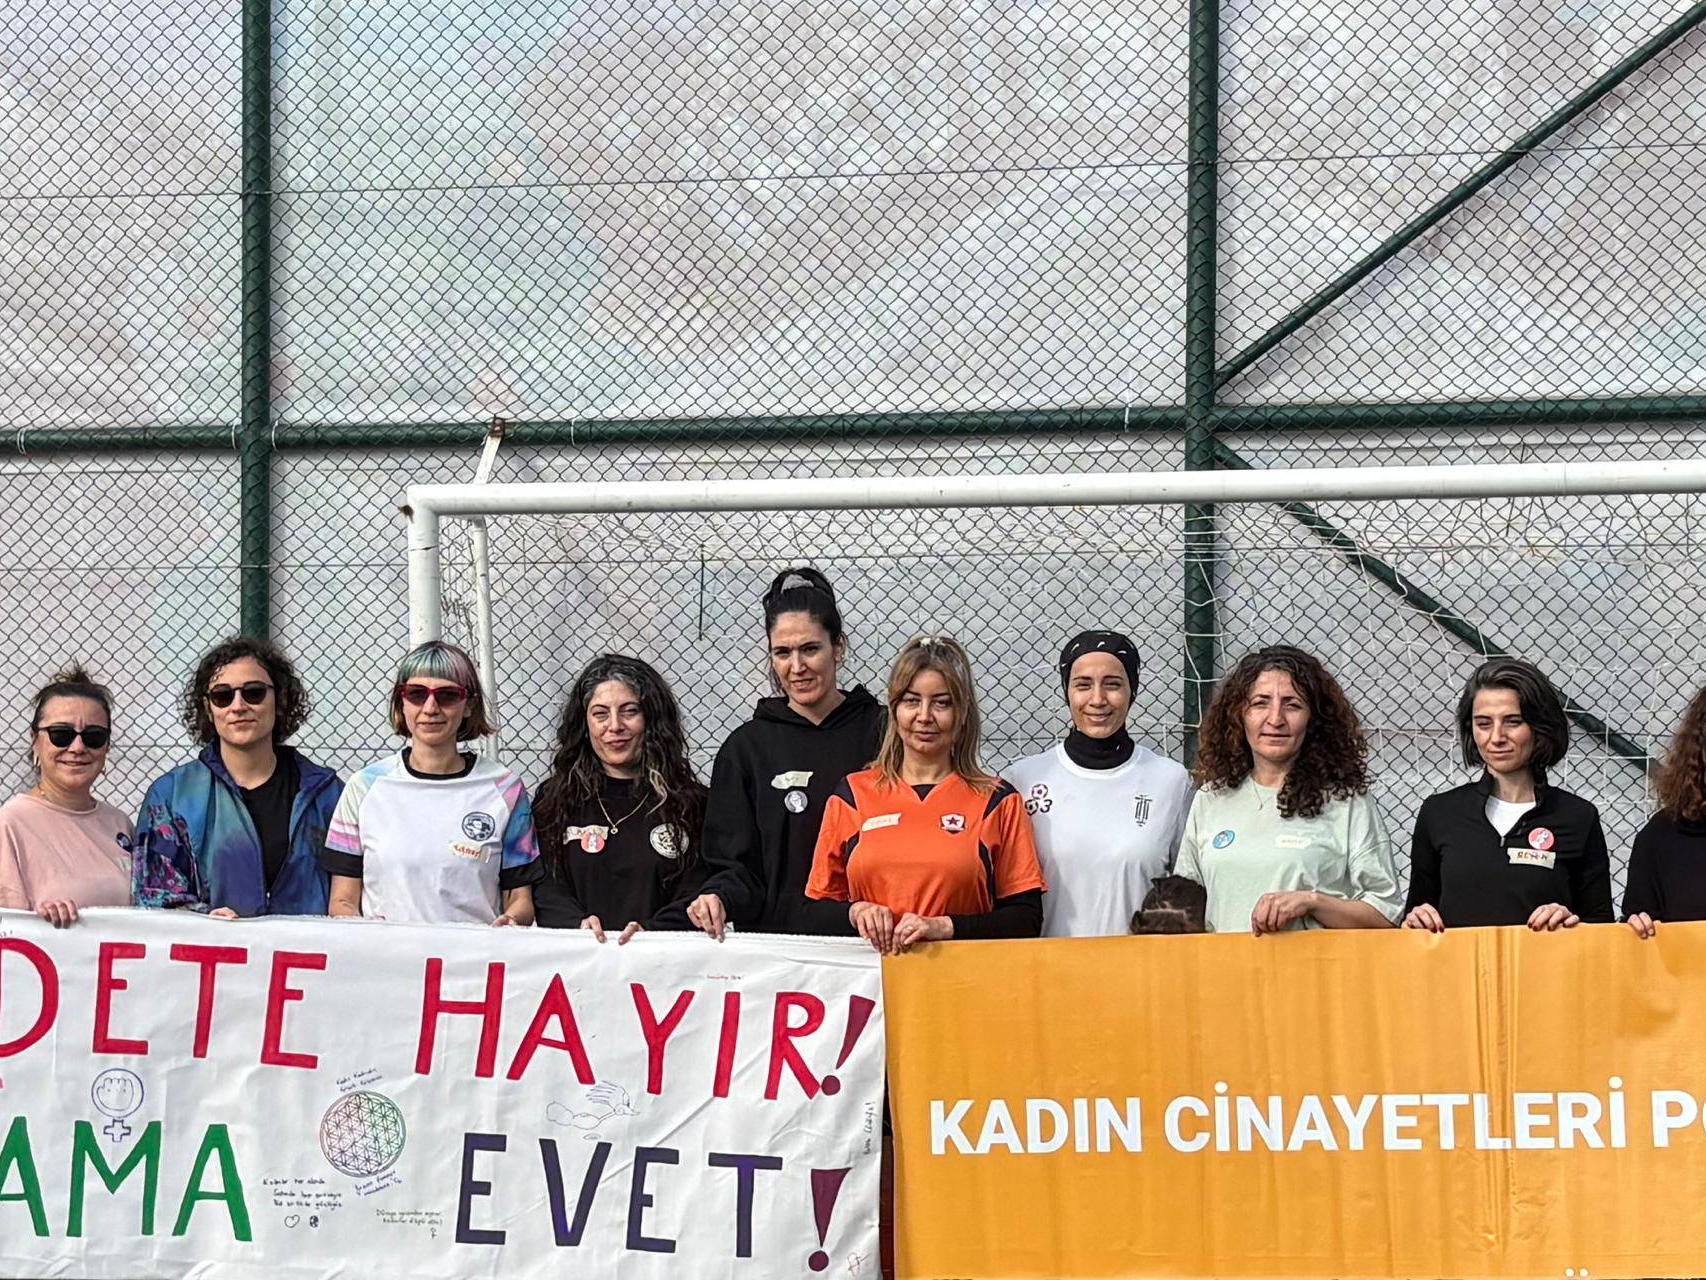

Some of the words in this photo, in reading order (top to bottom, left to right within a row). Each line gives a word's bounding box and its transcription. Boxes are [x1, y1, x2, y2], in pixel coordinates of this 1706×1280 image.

[415, 957, 877, 1101] HAYIR!
[930, 1097, 1142, 1155] KADIN
[1164, 1076, 1627, 1153] CİNAYETLERİ
[455, 1132, 852, 1272] EVET!
